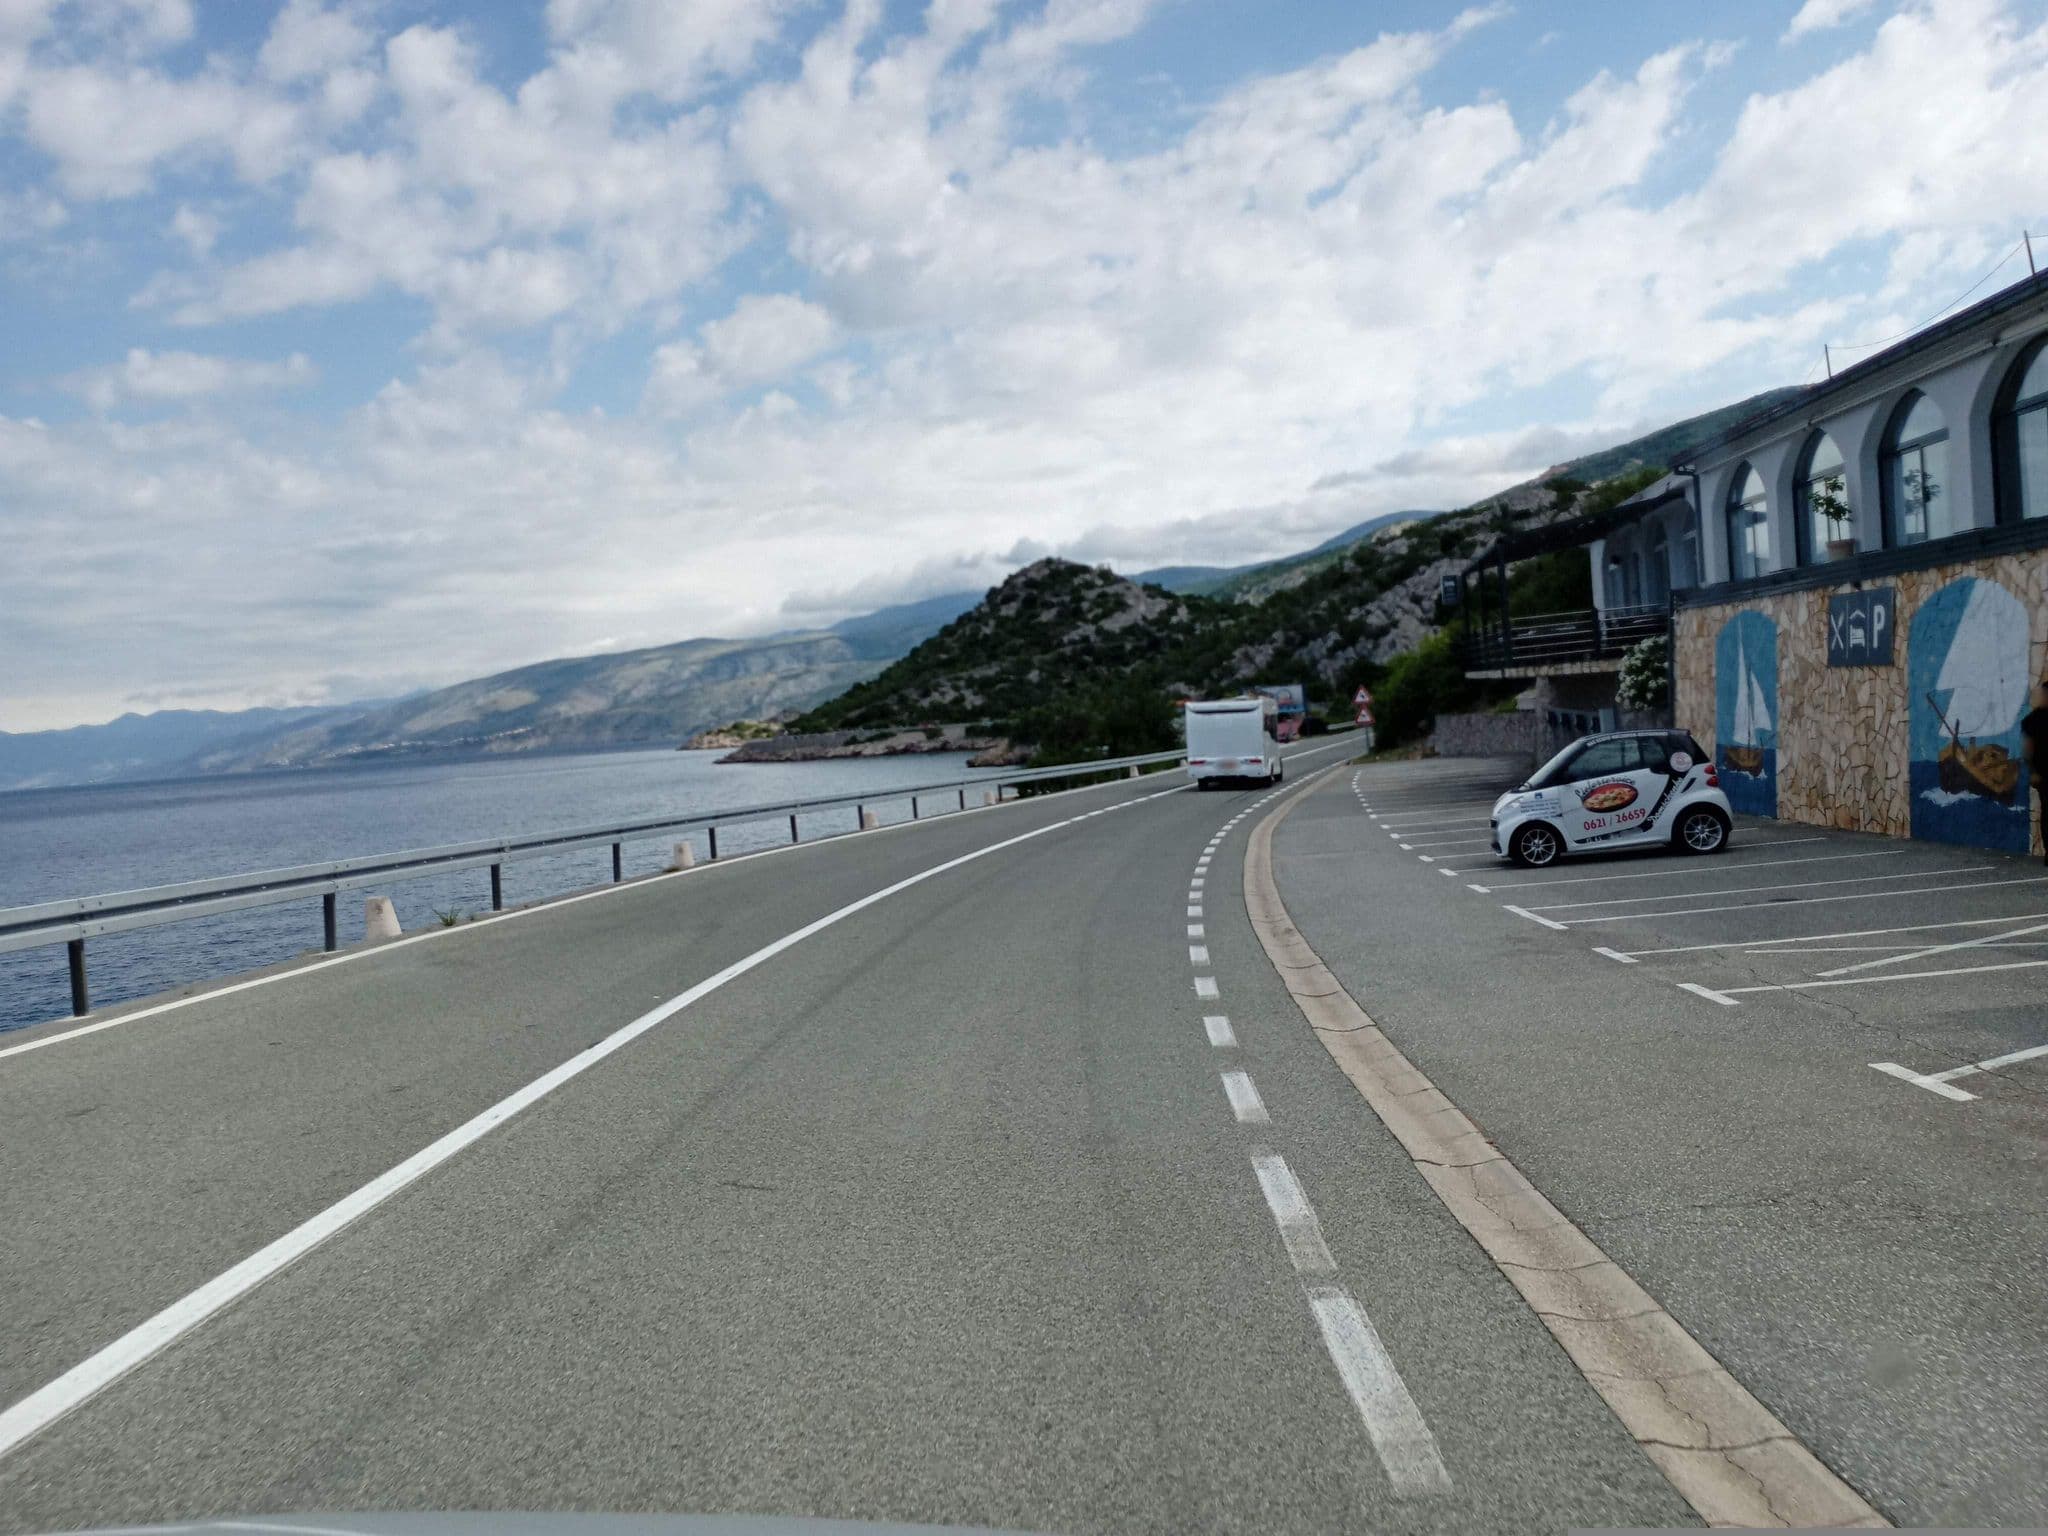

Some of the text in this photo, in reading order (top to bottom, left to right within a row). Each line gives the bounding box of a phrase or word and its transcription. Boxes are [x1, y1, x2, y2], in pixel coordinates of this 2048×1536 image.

[1872, 604, 1886, 649] P
[1583, 817, 1606, 831] 0621
[1616, 808, 1646, 824] 26659
